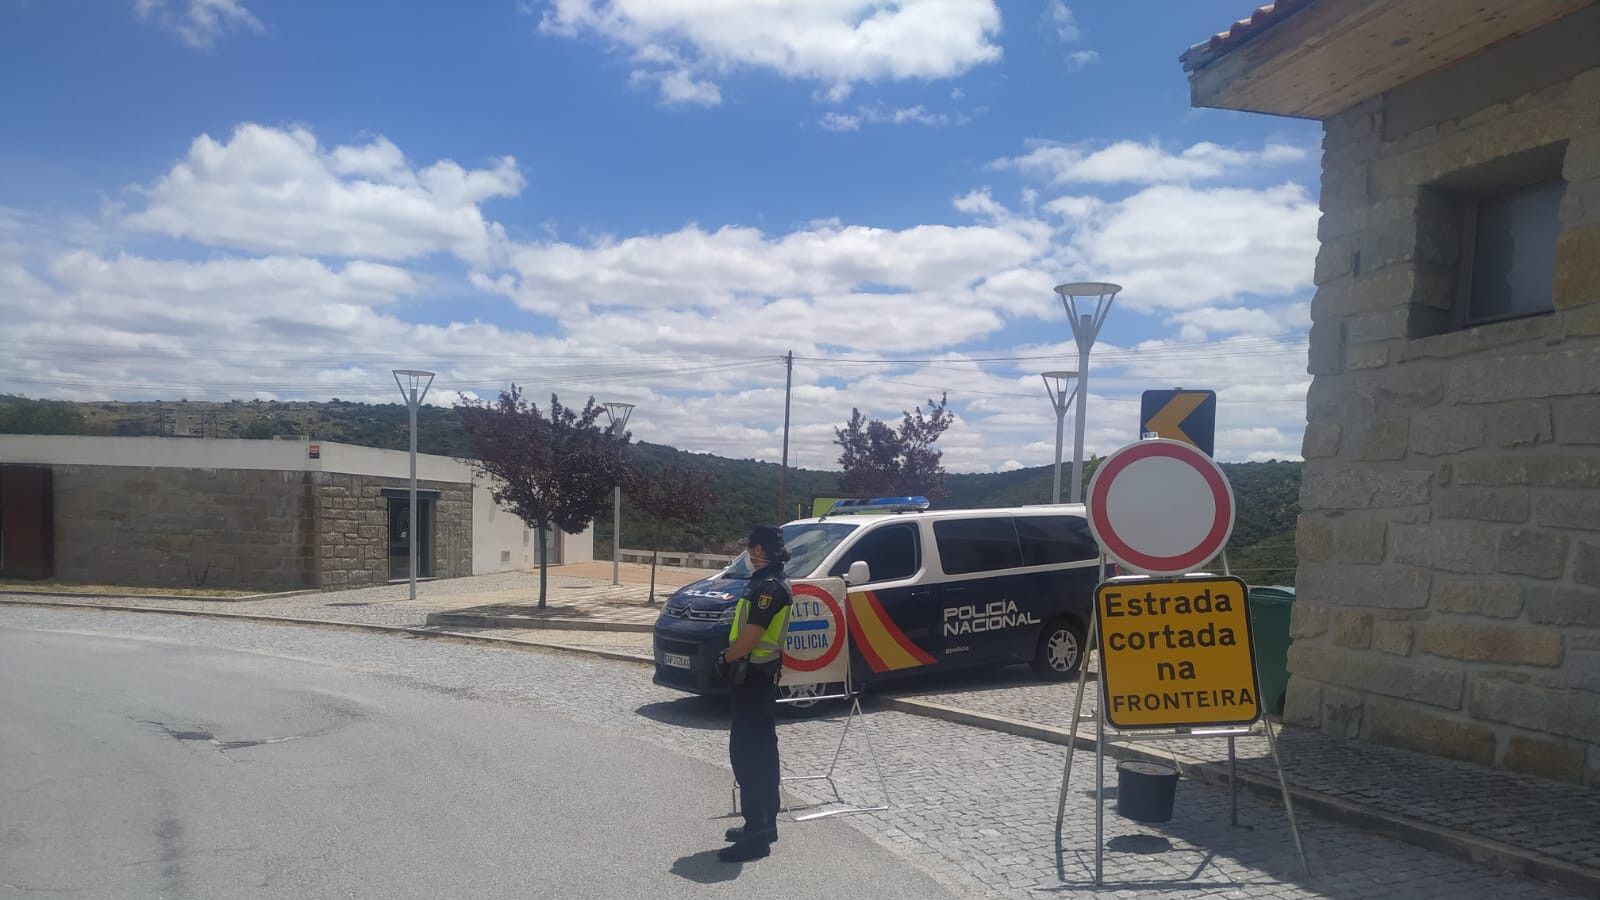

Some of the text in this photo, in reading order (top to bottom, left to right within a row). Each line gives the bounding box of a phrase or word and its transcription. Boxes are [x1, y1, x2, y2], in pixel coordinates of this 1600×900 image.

[1105, 589, 1233, 617] Estrada
[943, 611, 1041, 637] NACIONAL
[786, 633, 829, 650] POLICIA
[1109, 623, 1237, 651] cortada
[1157, 660, 1196, 681] na
[1113, 688, 1254, 712] FRONTEIRA
